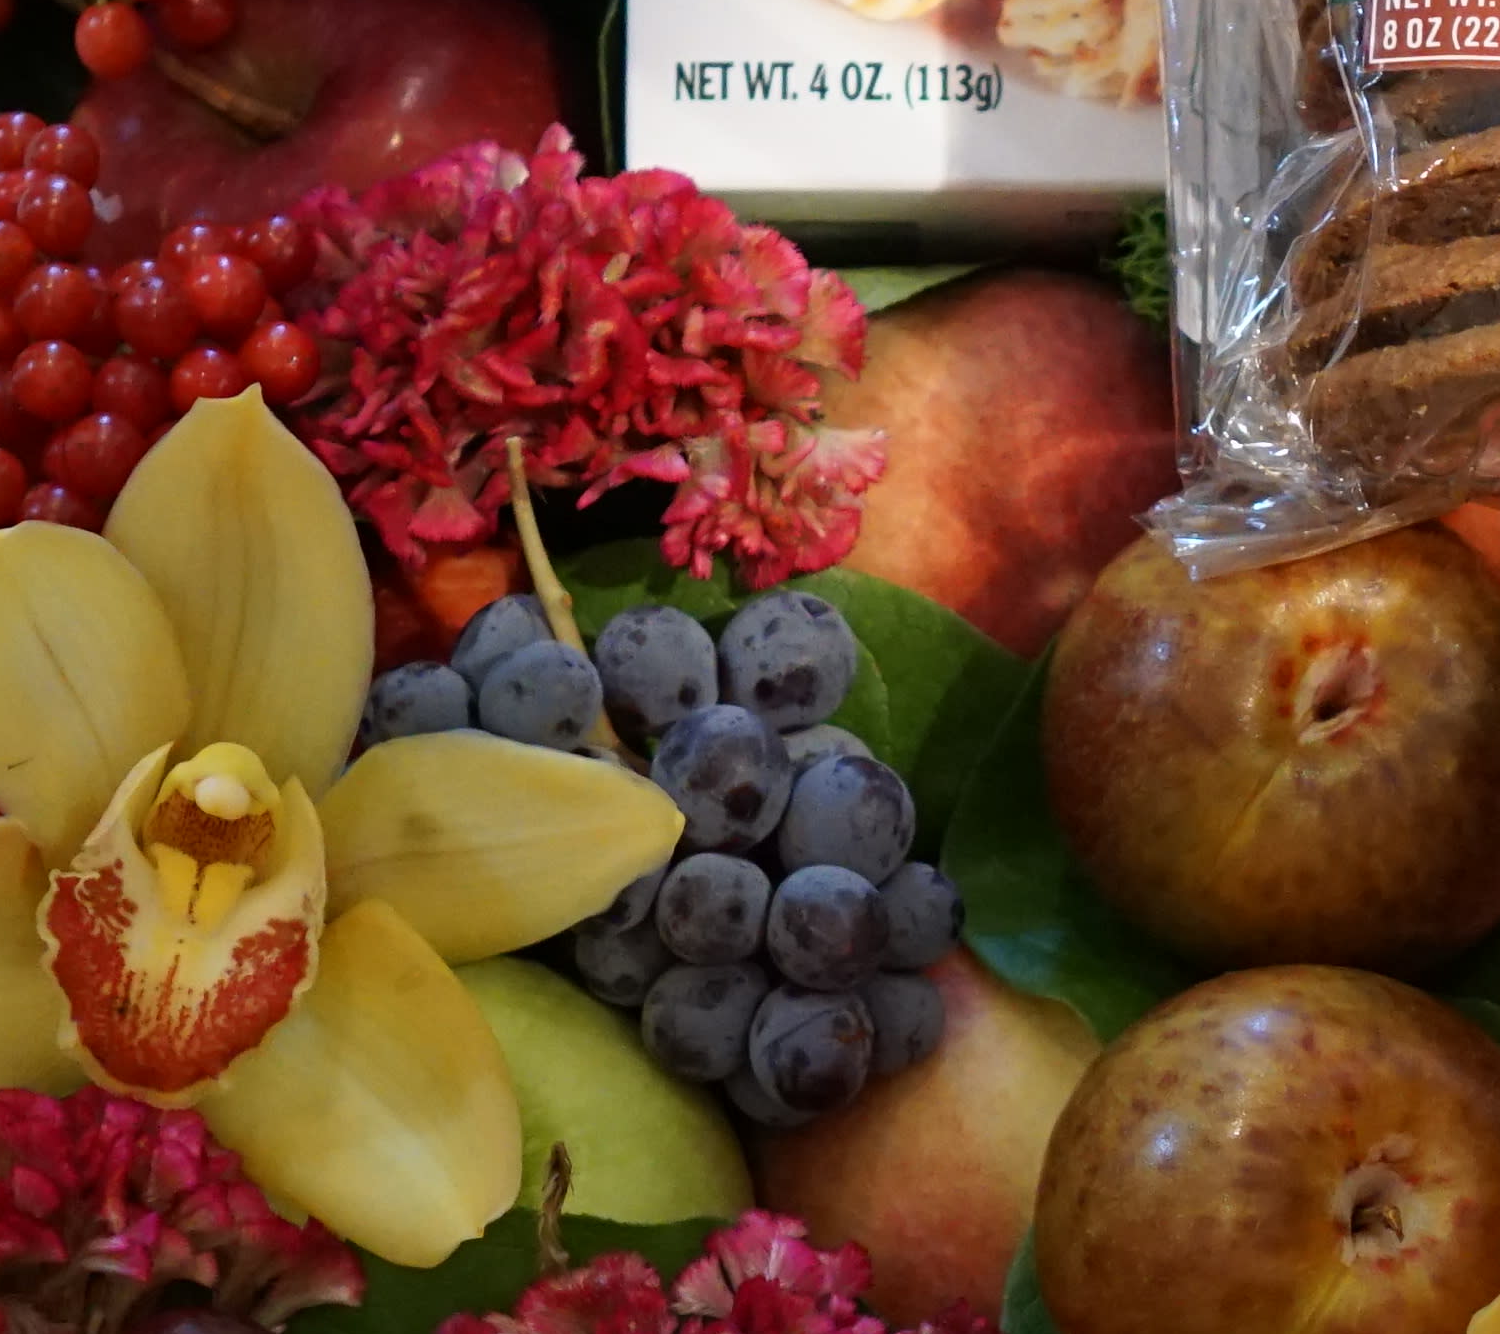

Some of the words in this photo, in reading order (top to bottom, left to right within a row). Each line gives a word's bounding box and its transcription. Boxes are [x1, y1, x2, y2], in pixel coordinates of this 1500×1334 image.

[1382, 19, 1398, 50] 8
[1406, 17, 1443, 49] OZ
[674, 61, 735, 101] NET
[745, 62, 798, 101] WT.
[809, 63, 828, 101] 4
[841, 63, 893, 102] OZ.
[904, 62, 1003, 112] (113g)
